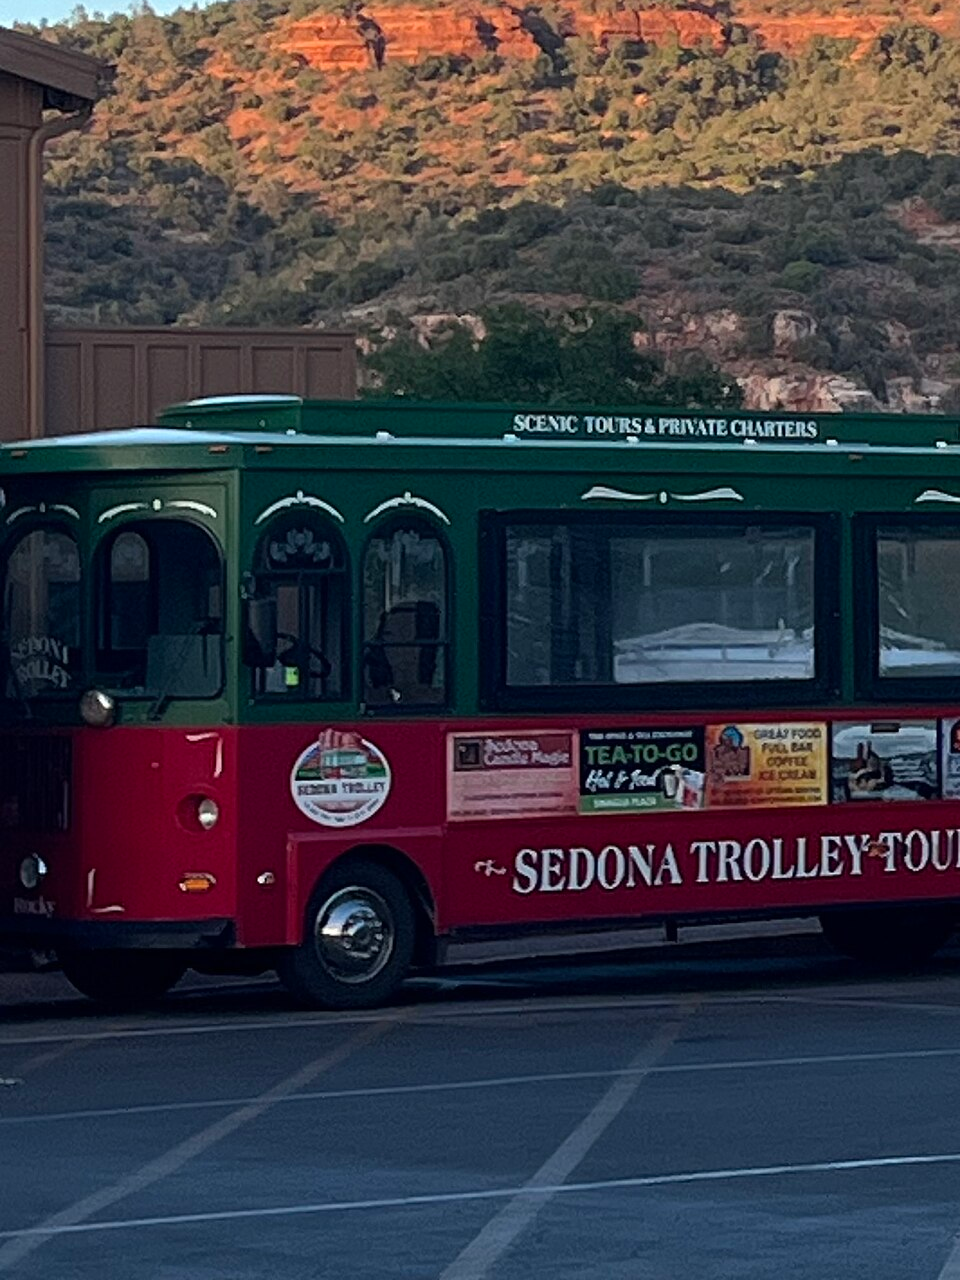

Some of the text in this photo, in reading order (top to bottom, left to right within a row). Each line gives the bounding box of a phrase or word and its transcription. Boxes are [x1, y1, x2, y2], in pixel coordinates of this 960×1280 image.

[513, 414, 819, 439] SCENIC TOURS & PRIVATE CHARTERS
[753, 727, 822, 740] GREAT FOOD
[584, 743, 698, 765] TEA-TO-GO
[761, 742, 813, 754] FULL BAR
[766, 756, 808, 767] COFFEE
[512, 842, 683, 894] SEDONA
[689, 833, 870, 882] TROLLEY
